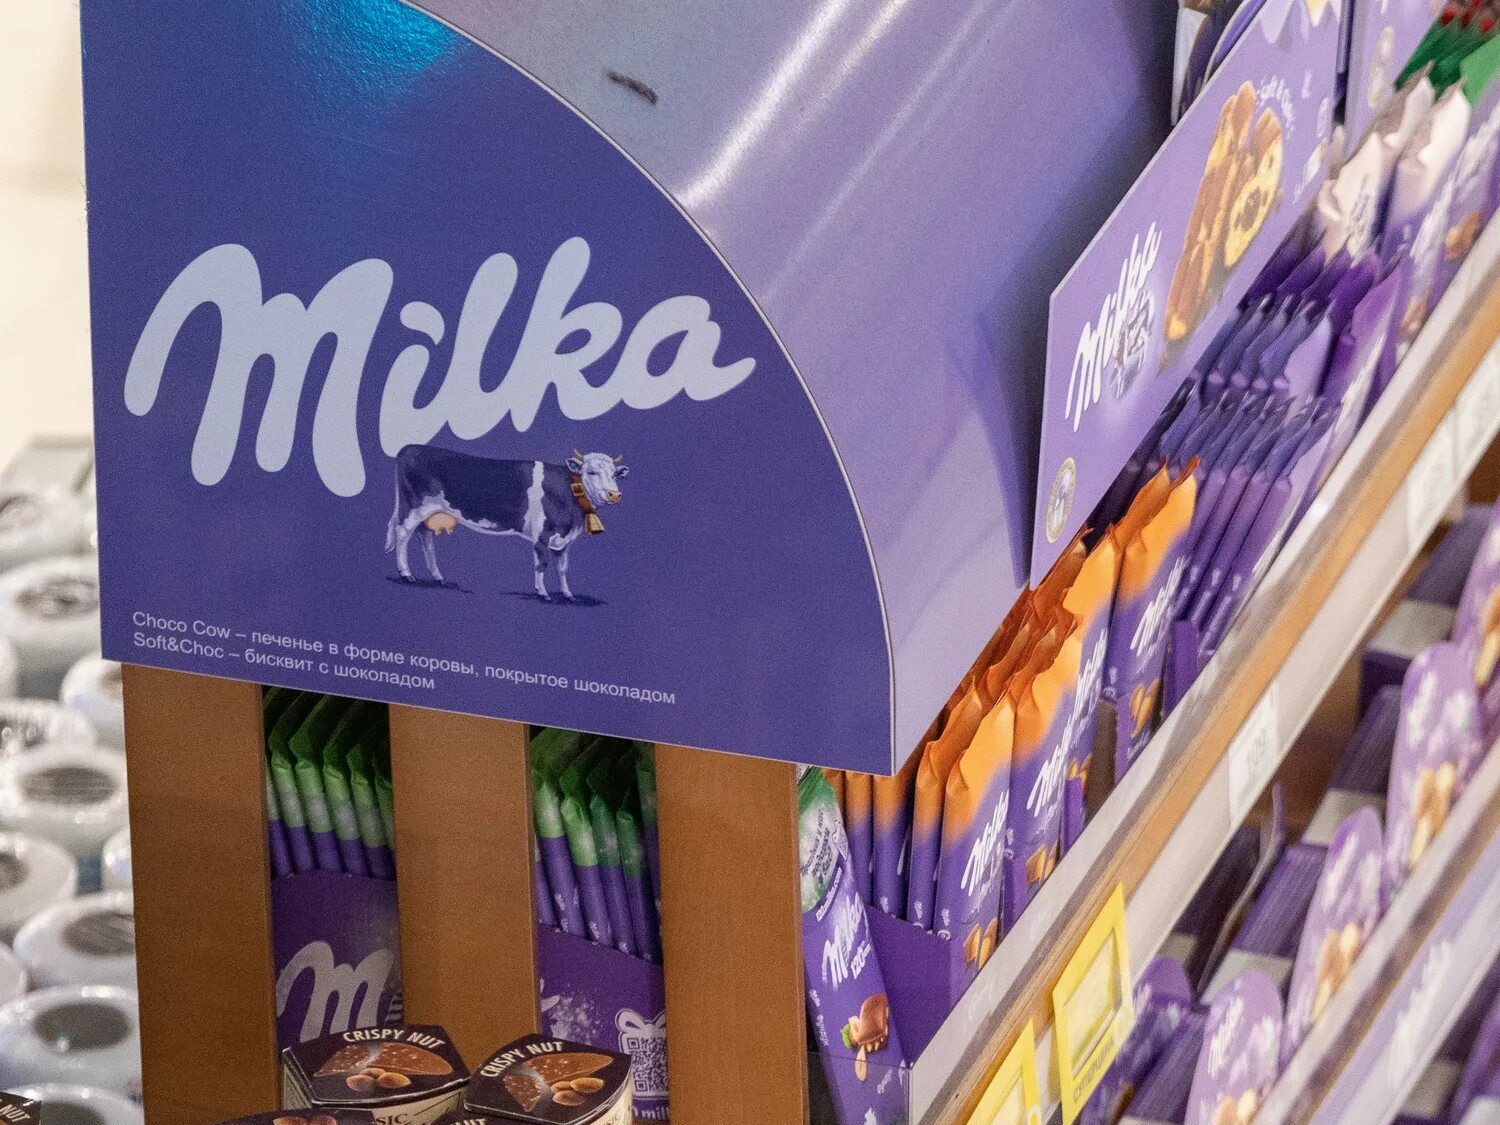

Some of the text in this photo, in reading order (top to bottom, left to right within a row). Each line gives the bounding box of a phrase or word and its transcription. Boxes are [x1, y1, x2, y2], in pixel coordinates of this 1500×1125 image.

[1065, 221, 1162, 432] Milka
[124, 237, 757, 498] Milka
[132, 611, 188, 633] Choco
[192, 620, 231, 640] Cow
[251, 632, 323, 653] печенье
[328, 643, 340, 655] в
[343, 643, 405, 666] форме
[410, 654, 479, 678] коровы,
[484, 665, 569, 688] покрытое
[573, 679, 676, 705] шоколадом
[133, 632, 225, 660] Soft&Choc
[244, 648, 314, 672] бисквит
[318, 662, 330, 674] с
[333, 665, 436, 690] шоколадом
[821, 891, 865, 991] Milka
[343, 1028, 446, 1050] CRISPY NUT
[480, 1041, 564, 1078] CRISPY NUT
[1, 1103, 31, 1123] NUT
